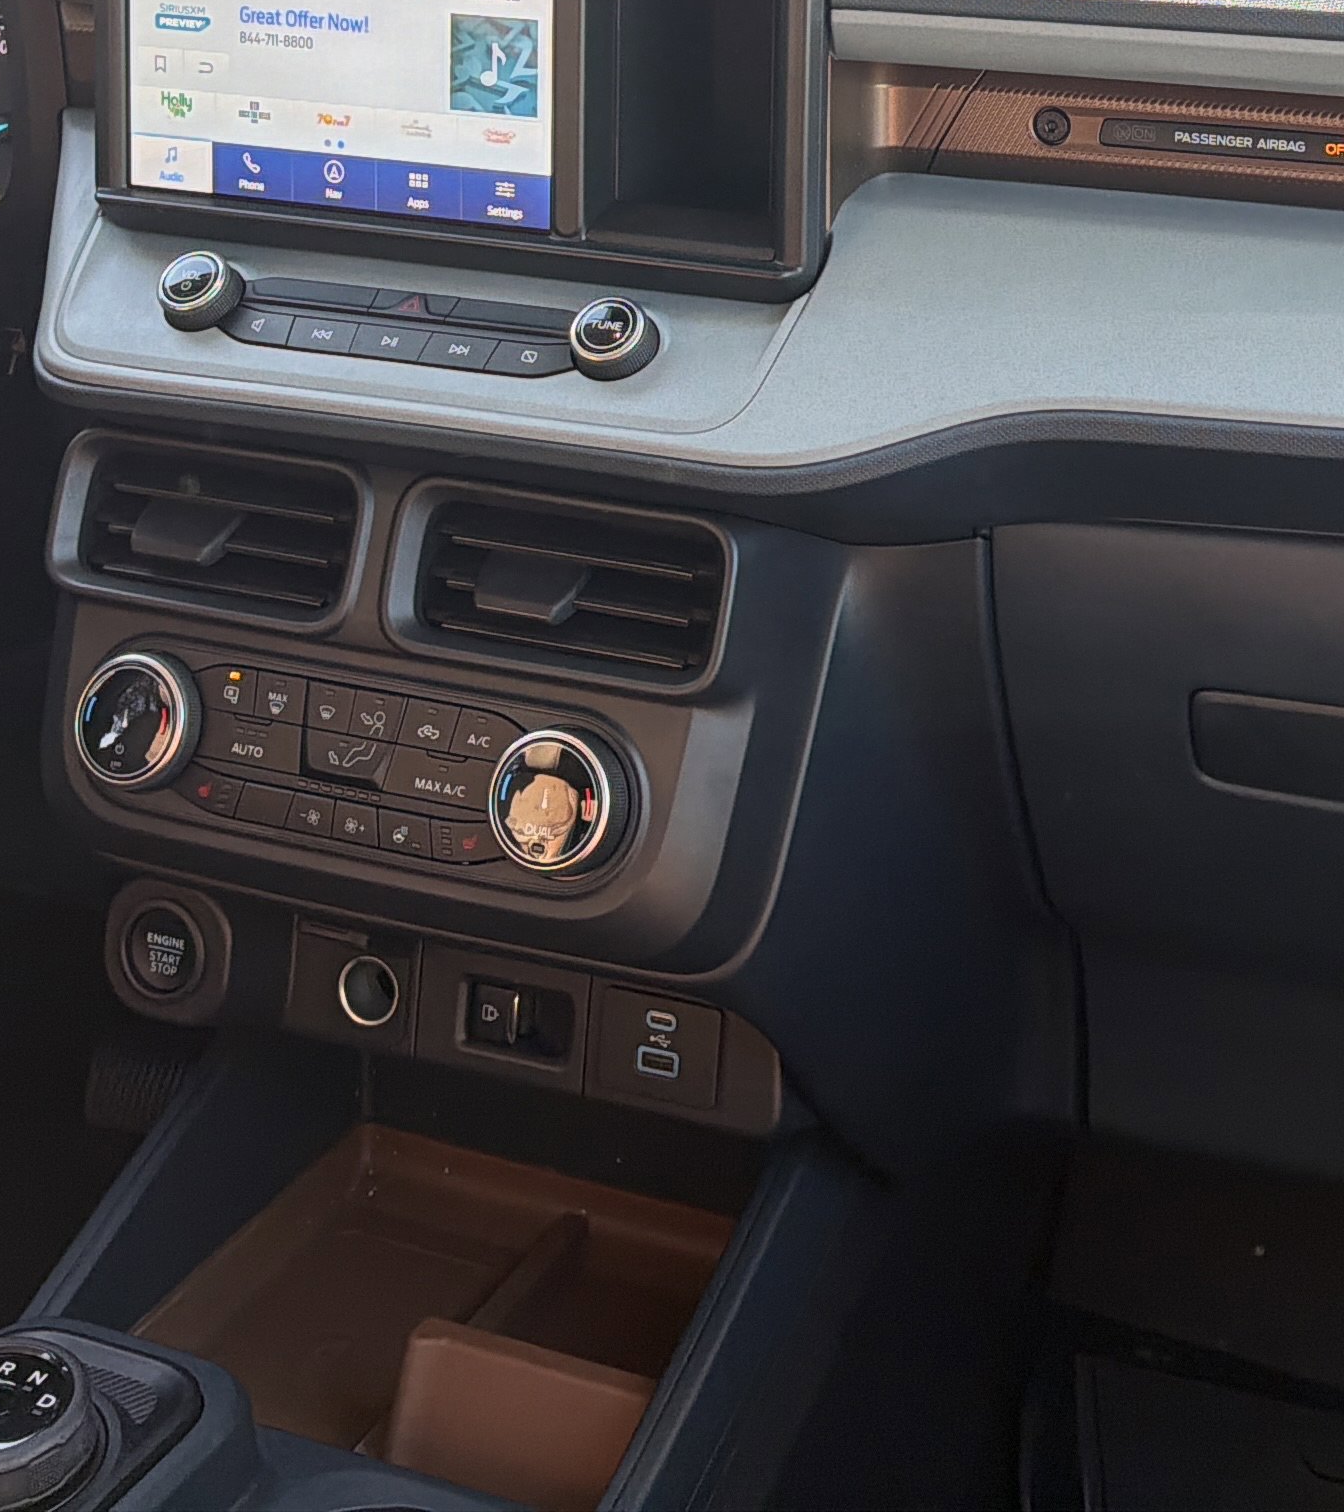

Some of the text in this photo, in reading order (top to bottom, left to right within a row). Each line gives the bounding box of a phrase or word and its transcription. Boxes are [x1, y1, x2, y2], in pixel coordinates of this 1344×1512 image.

[159, 2, 206, 15] SIRIUSXM
[239, 6, 370, 33] Great Offer Now!
[239, 31, 314, 50] 844-711-8800
[160, 90, 193, 112] Holly
[1174, 130, 1253, 150] PASSENGER
[1256, 136, 1306, 153] AIRBAG
[159, 169, 184, 183] Audio
[238, 178, 265, 192] Phone
[325, 188, 343, 200] Nav
[407, 197, 429, 211] Apps
[487, 205, 524, 220] Settings
[181, 269, 202, 282] VOL
[592, 319, 624, 333] TUNE
[267, 691, 288, 705] MAX
[467, 732, 491, 749] A/C
[230, 741, 264, 760] AUTO
[414, 776, 467, 799] MAX A/C
[523, 823, 555, 840] DUAL
[147, 931, 185, 950] ENGINE
[149, 950, 182, 966] START
[150, 961, 178, 976] STOP
[27, 1370, 49, 1386] N
[35, 1394, 56, 1409] D
